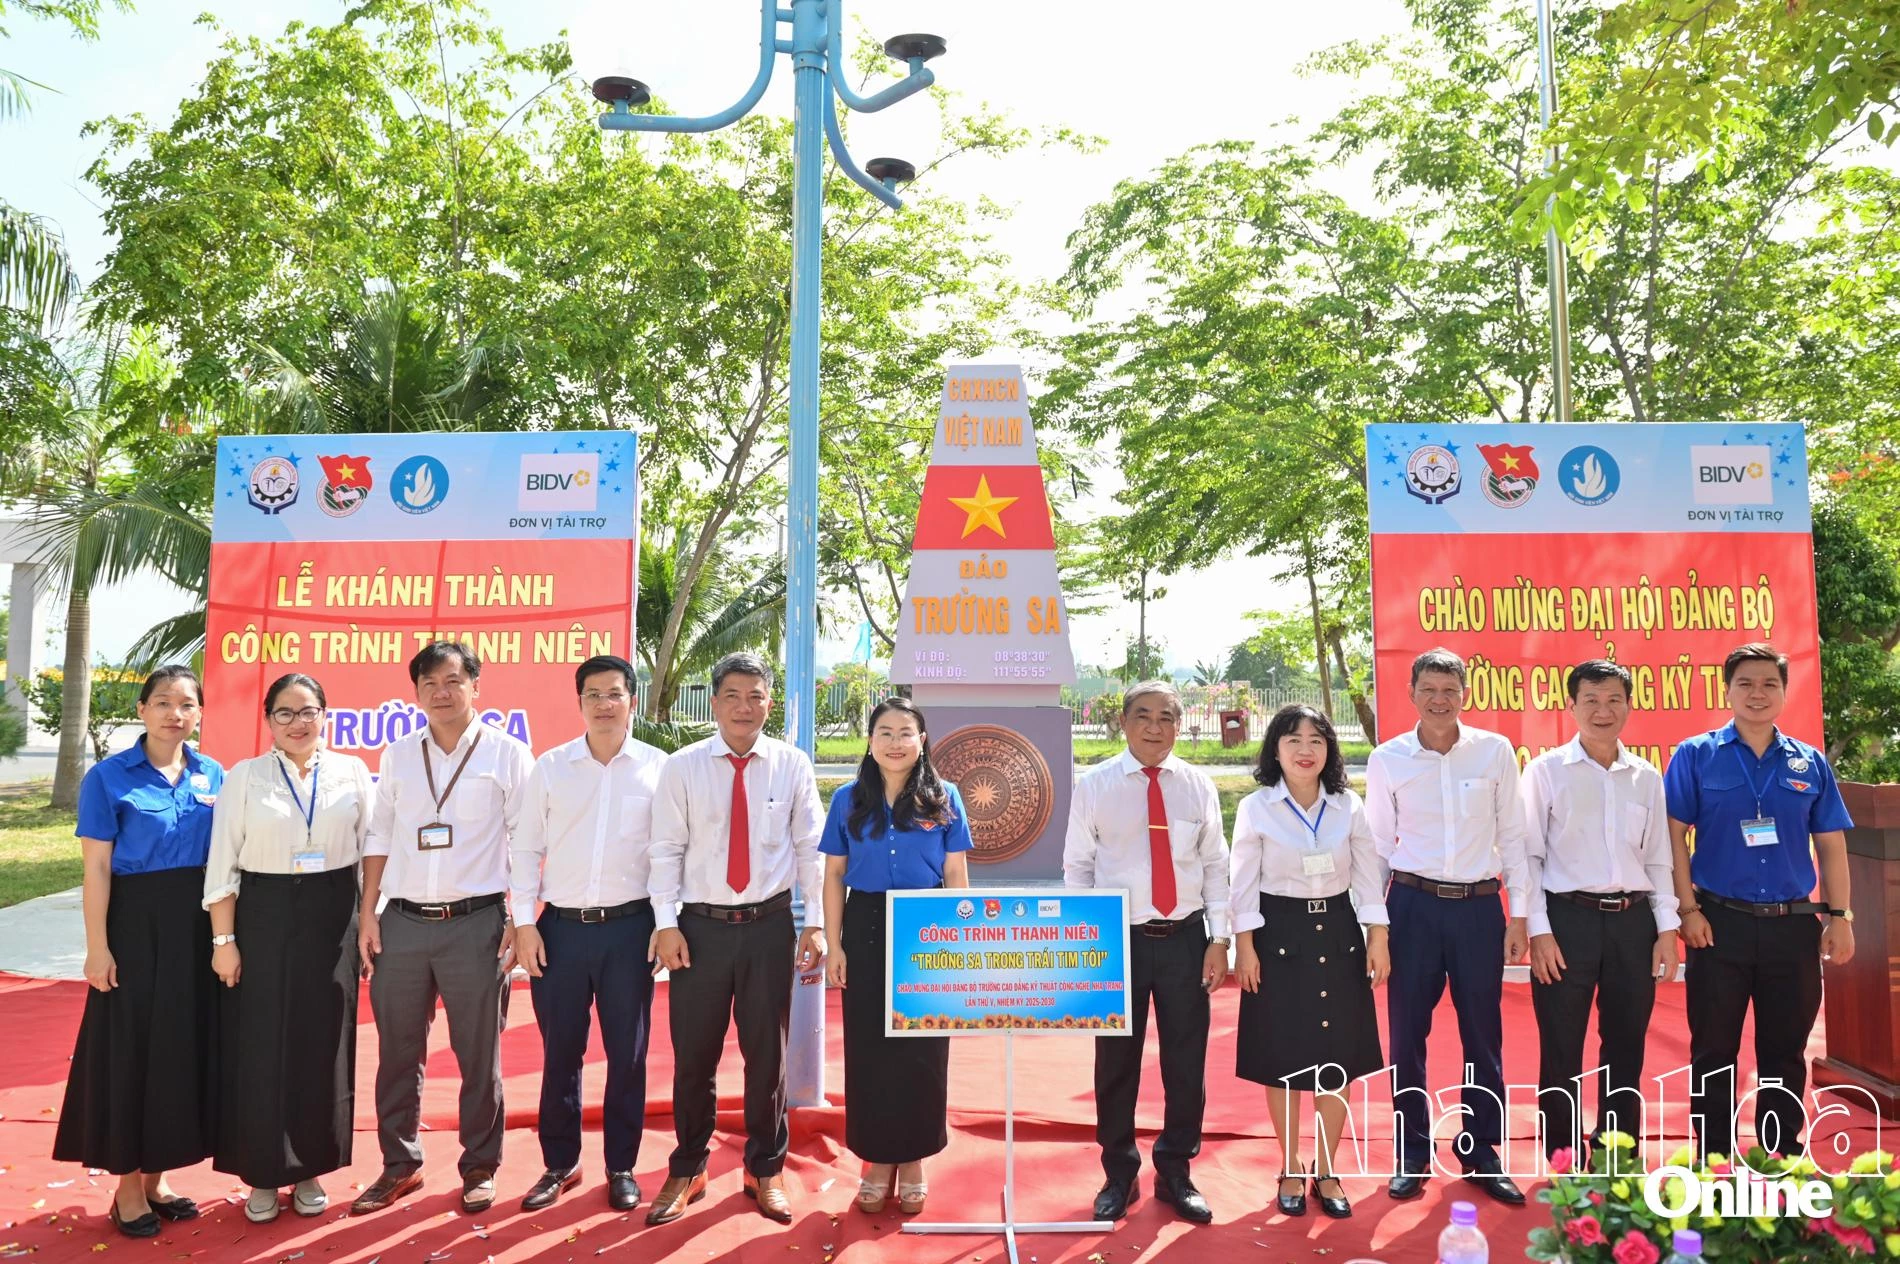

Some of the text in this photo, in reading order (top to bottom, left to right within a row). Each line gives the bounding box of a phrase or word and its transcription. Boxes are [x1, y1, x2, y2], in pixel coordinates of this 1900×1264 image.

[949, 377, 1019, 401] CHXHCN
[944, 413, 1023, 451] VIỆT NAM
[526, 473, 572, 491] BIDV
[1700, 466, 1746, 483] BIDV
[509, 514, 606, 530] ĐƠN VỊ TÀI TRỢ
[1688, 507, 1784, 523] ĐƠN VỊ TÀI TRỢ
[959, 552, 1008, 579] ĐẢO
[277, 560, 554, 607] LỄ KHÁNH THÀNH
[912, 587, 1061, 635] TRƯỜNG SA
[1419, 569, 1775, 640] CHÀO MỪNG ĐẠI HỘI ĐẢNG BỘ
[221, 623, 300, 664] CÔNG
[309, 623, 401, 664] TRÌNH
[533, 622, 611, 664] NIÊN
[914, 665, 943, 678] KINH
[1660, 653, 1694, 710] KỸ
[919, 921, 1099, 943] CÔNG TRÌNH THANH NIÊN
[967, 952, 983, 970] SA
[985, 952, 1025, 969] TRONG
[1027, 946, 1054, 969] TRÁI
[1057, 951, 1078, 968] TIM
[1001, 982, 1013, 992] CAO
[1092, 981, 1103, 991] NHA
[1104, 981, 1123, 991] TRANG
[1025, 996, 1056, 1006] 2025-2030
